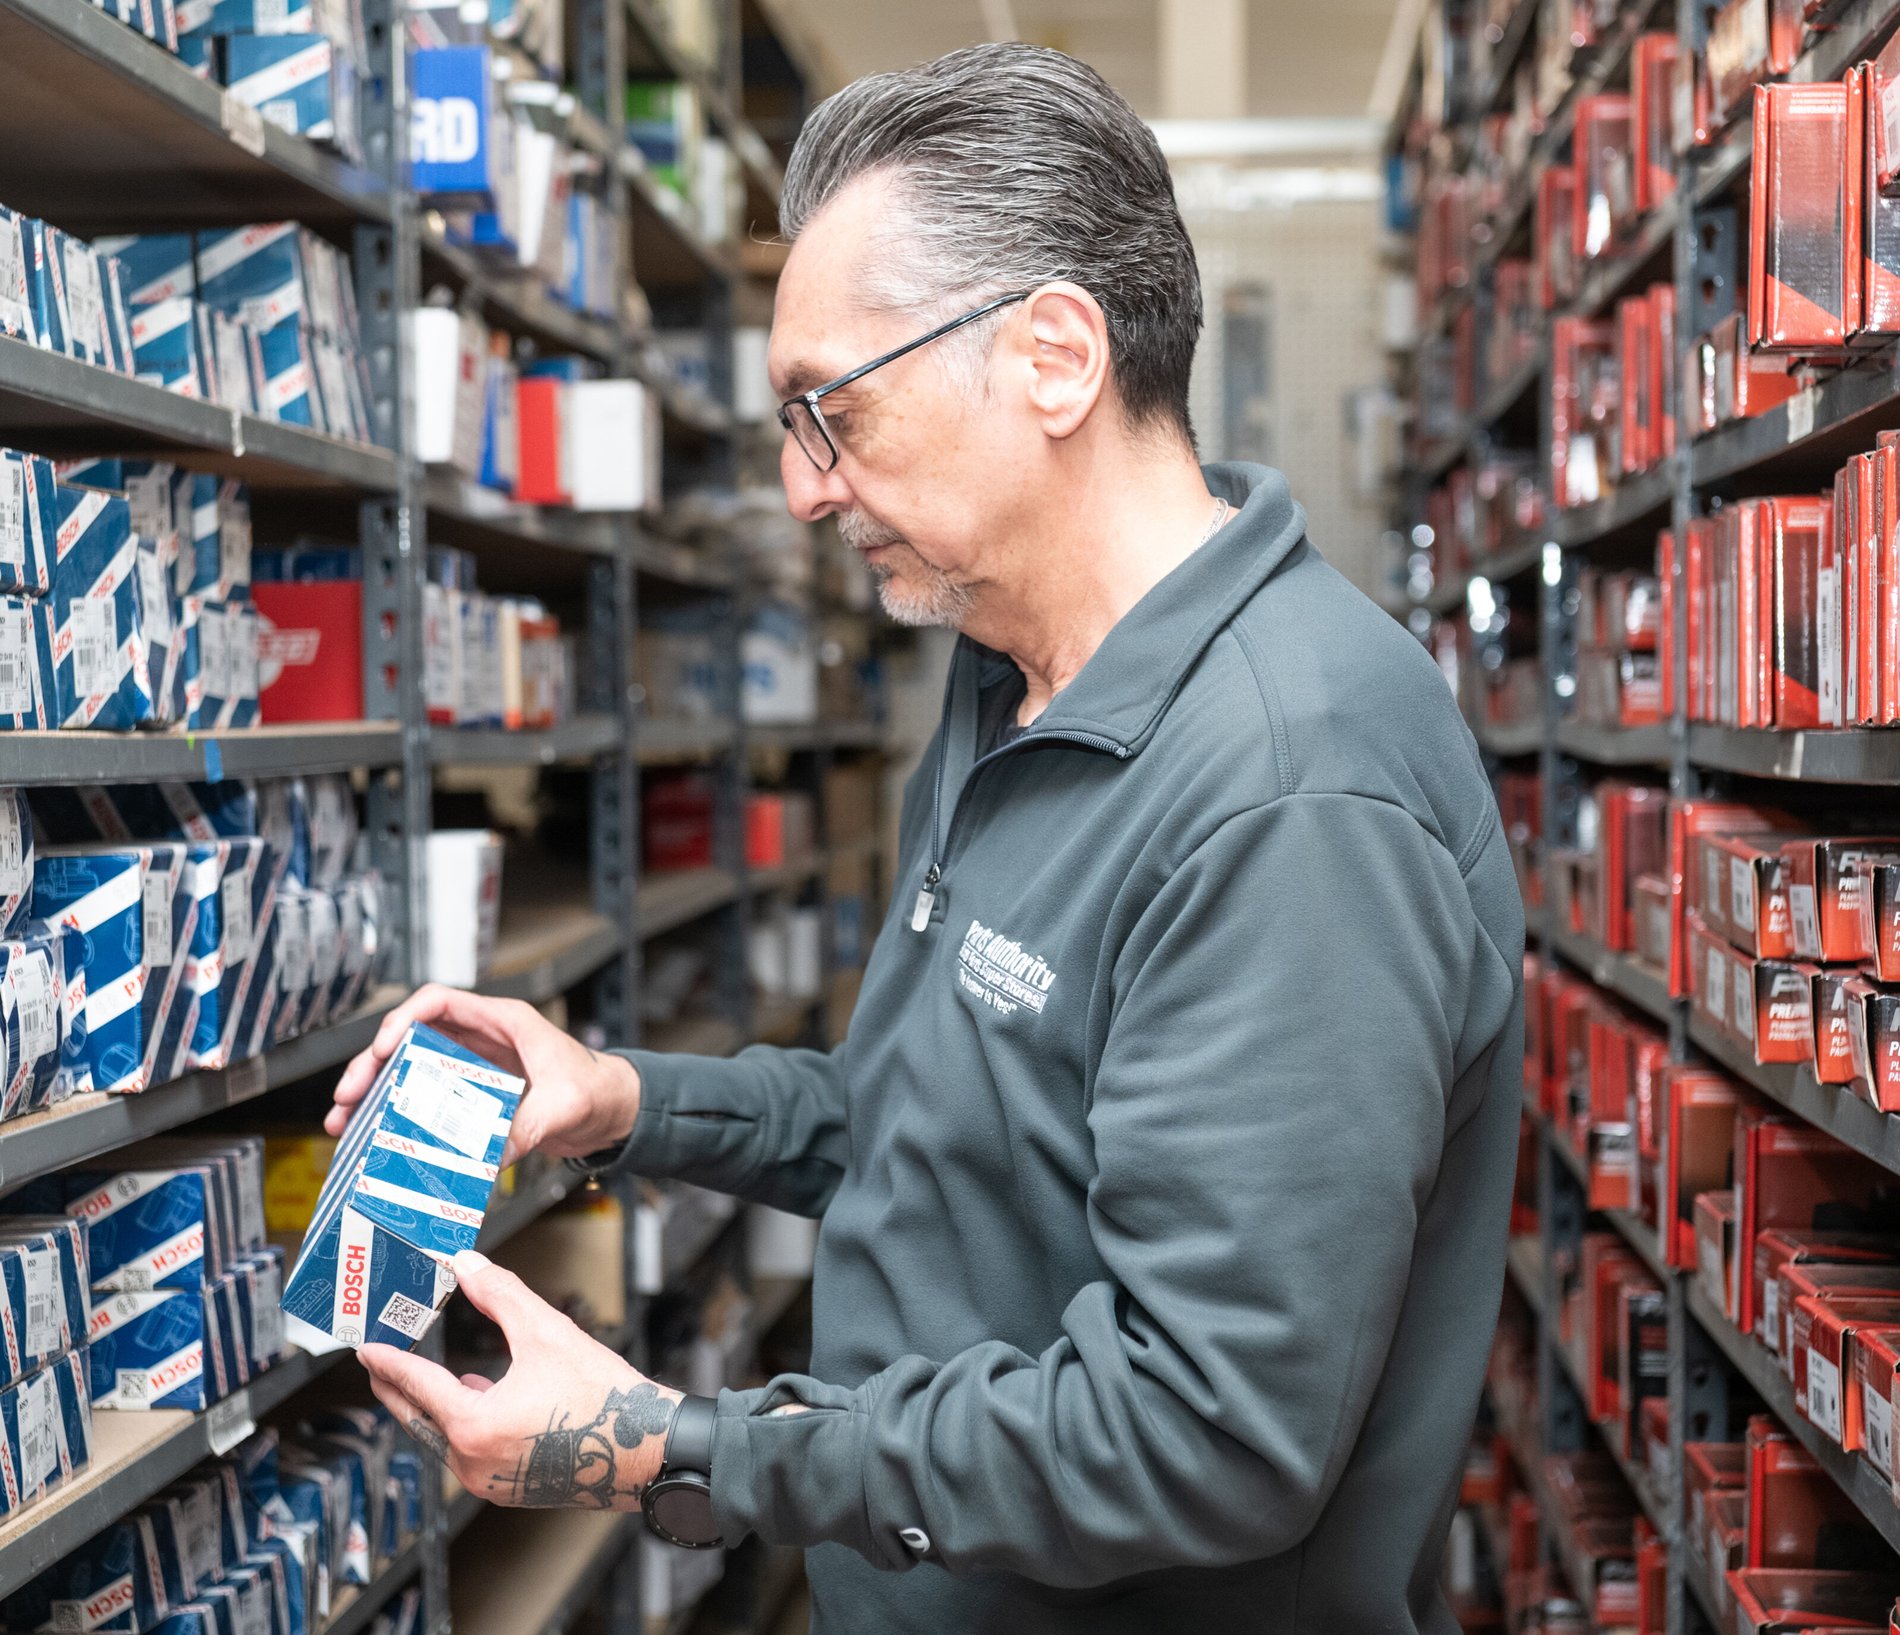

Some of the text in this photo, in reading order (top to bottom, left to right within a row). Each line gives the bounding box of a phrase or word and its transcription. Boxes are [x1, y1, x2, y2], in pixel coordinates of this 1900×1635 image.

[965, 920, 1056, 992] Parts Authority
[1002, 976, 1041, 1010] Stores
[440, 1058, 503, 1087] BOSCH
[373, 1132, 416, 1154] SCH
[151, 1231, 204, 1271] OSCH
[342, 1244, 366, 1316] BOSCH
[151, 1350, 203, 1389] OSCH
